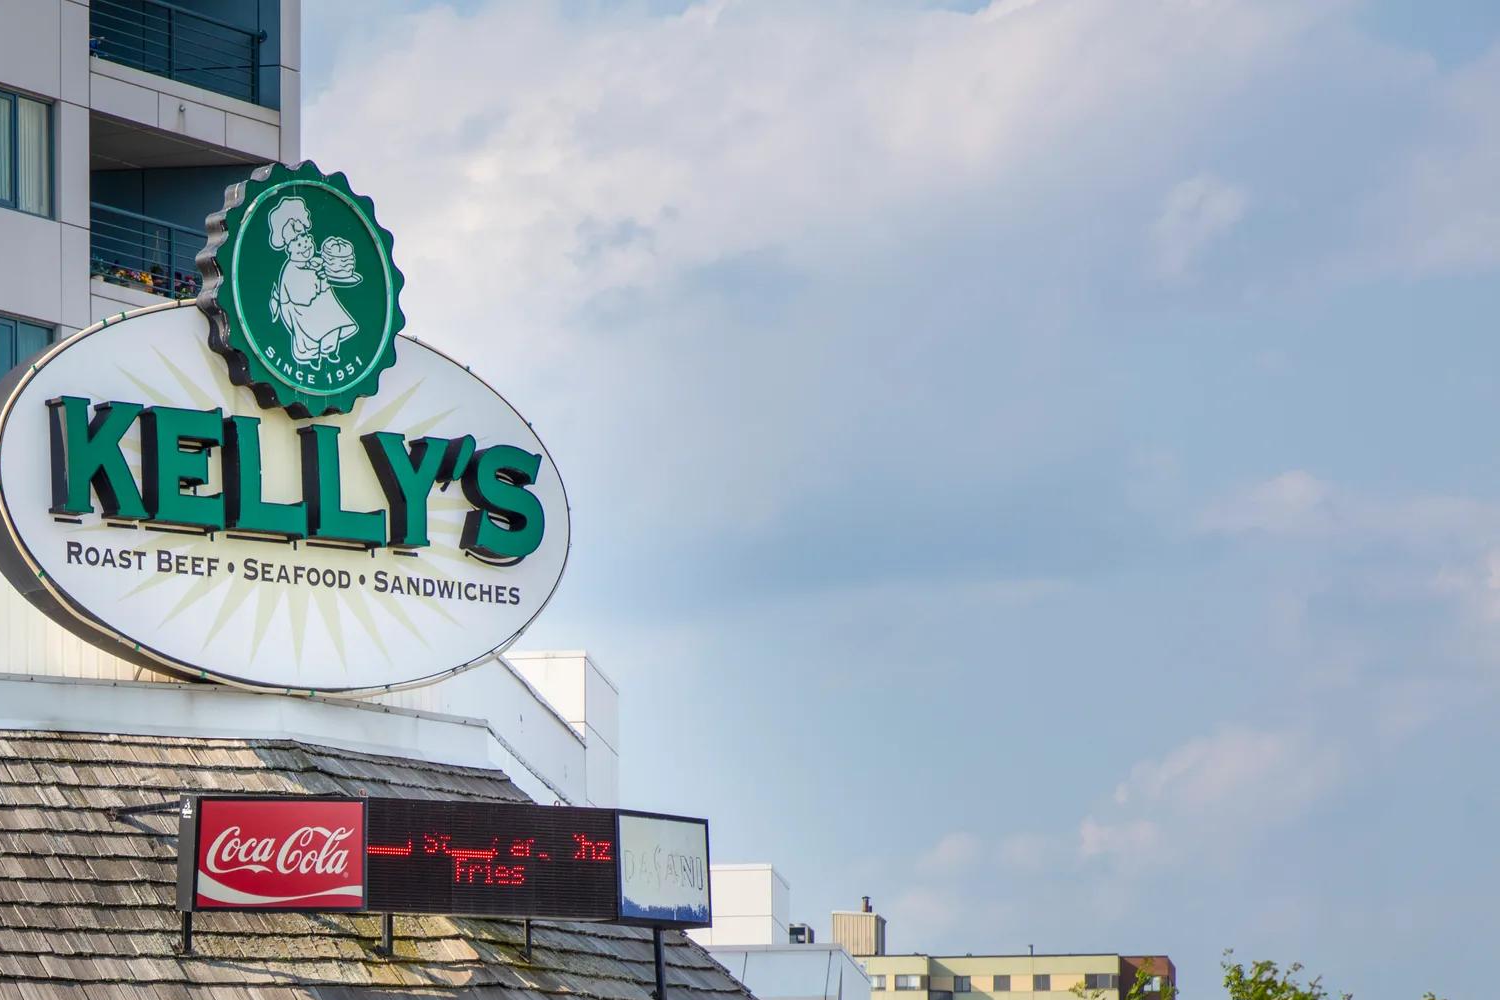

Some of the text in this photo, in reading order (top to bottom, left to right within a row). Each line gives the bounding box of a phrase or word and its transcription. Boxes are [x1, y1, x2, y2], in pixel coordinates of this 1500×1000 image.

[265, 346, 362, 384] SINCE 1951
[46, 395, 546, 560] KELLY'S
[66, 540, 521, 606] ROAST BEEF SEAFOOD SANDWICHES
[206, 826, 276, 874] Coca
[276, 826, 355, 875] Cola
[455, 857, 525, 884] Fries
